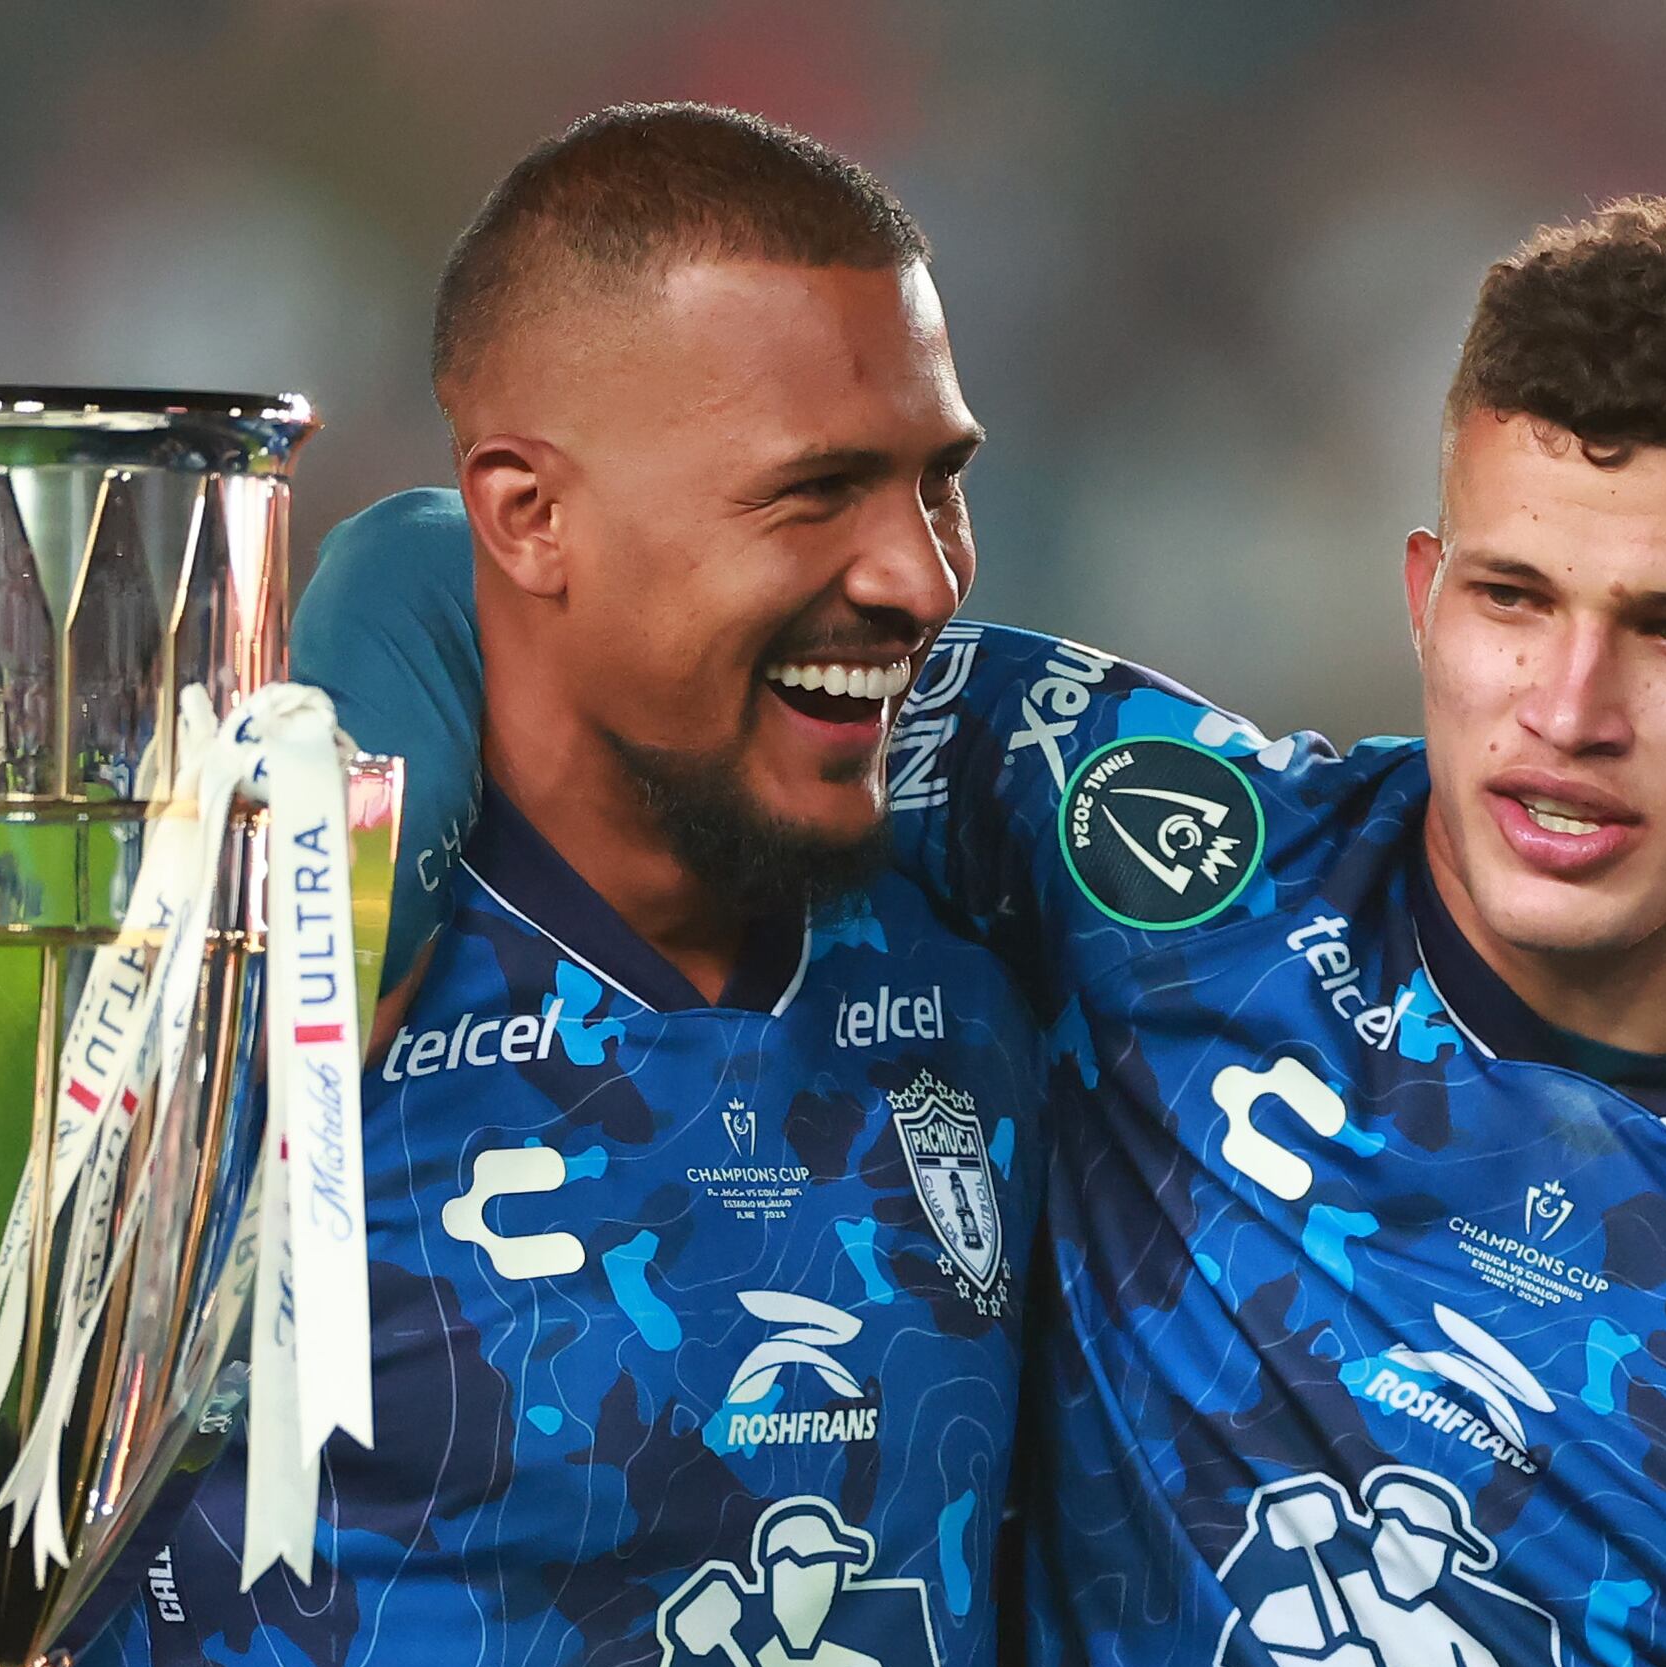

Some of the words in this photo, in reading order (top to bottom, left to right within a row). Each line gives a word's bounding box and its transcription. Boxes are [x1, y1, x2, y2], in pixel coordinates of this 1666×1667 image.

[1083, 750, 1135, 790] FINAL
[1072, 793, 1094, 849] 2024
[294, 819, 338, 1006] ULTRA
[1286, 915, 1415, 1051] telcel
[382, 998, 565, 1082] telcel
[835, 985, 945, 1048] telcel
[308, 1058, 354, 1242] Michelob
[911, 1121, 978, 1156] PACHUCA
[686, 1166, 778, 1182] CHAMPIONS
[779, 1166, 810, 1182] CUP
[923, 1175, 946, 1219] CLUB
[1448, 1217, 1566, 1276] CHAMPIONS
[1567, 1266, 1610, 1294] CUP
[1458, 1241, 1508, 1268] PACHUCA
[1510, 1262, 1524, 1276] VS
[1524, 1270, 1584, 1301] COLUMBUS
[1471, 1260, 1516, 1283] ESTADIO
[1516, 1278, 1562, 1304] HIDALGO
[1480, 1274, 1508, 1289] JUNE
[1517, 1290, 1546, 1308] 2024
[727, 1406, 879, 1446] ROSHFRANS
[1365, 1368, 1539, 1475] ROSHFRANS
